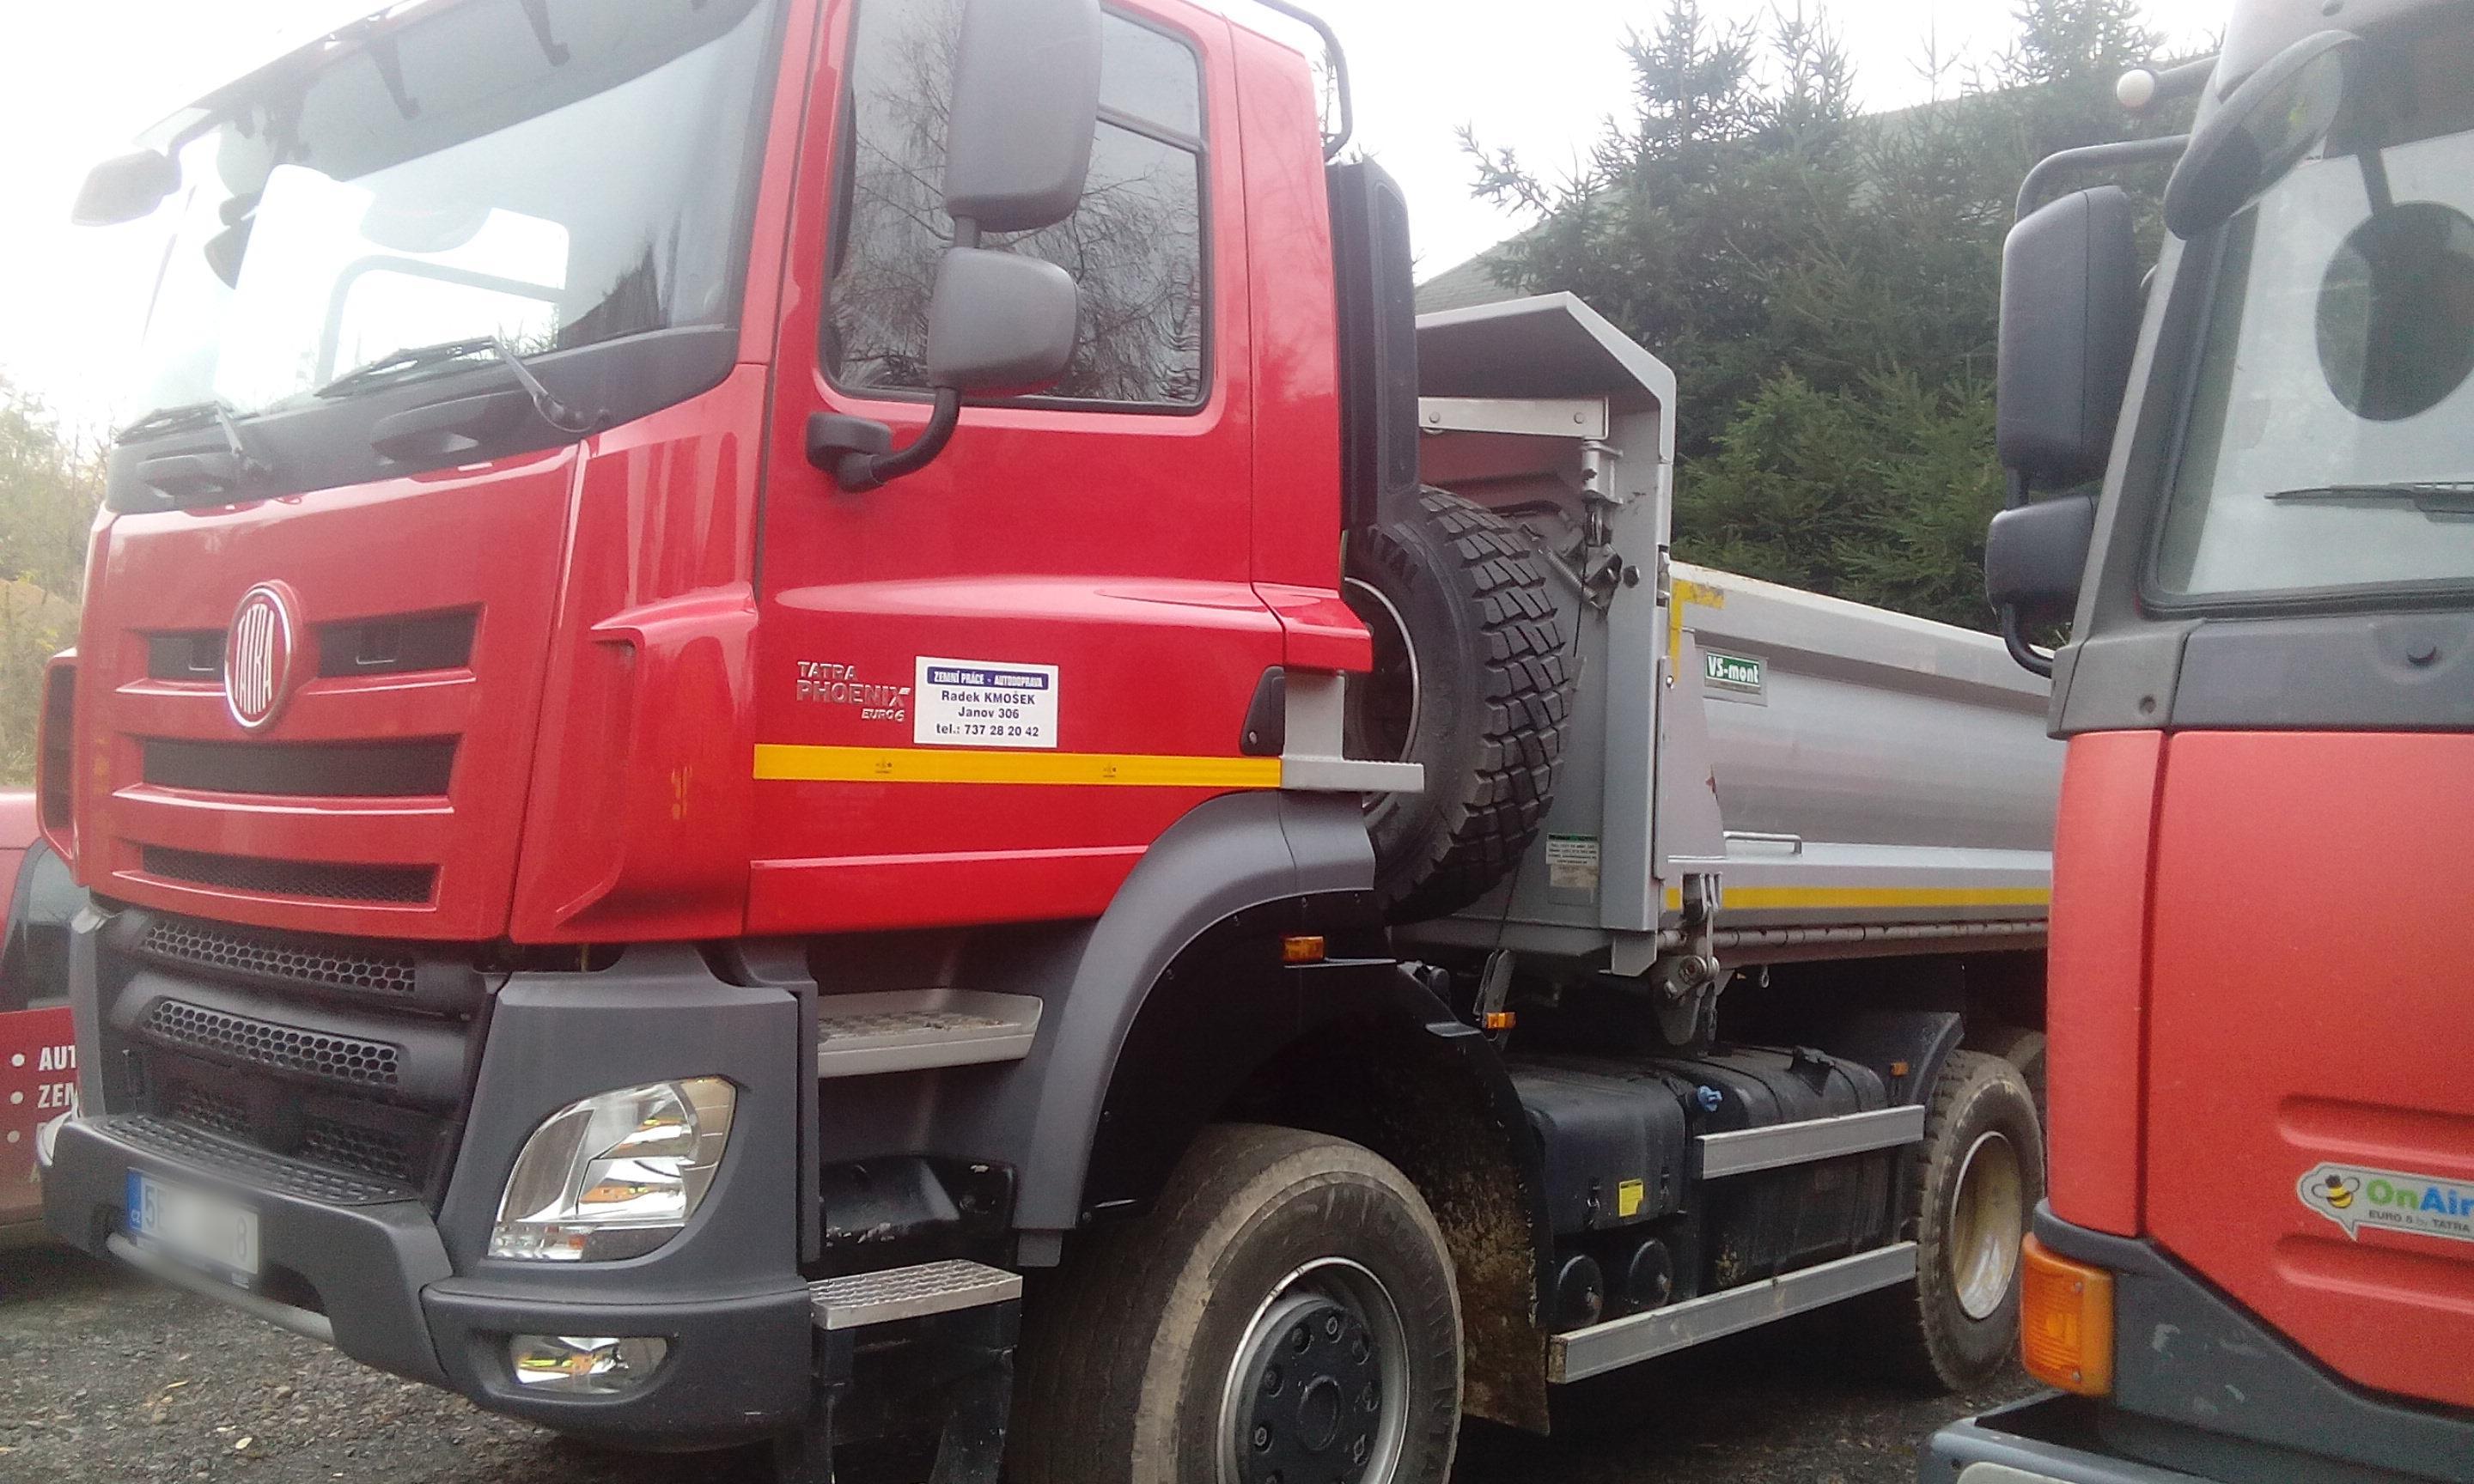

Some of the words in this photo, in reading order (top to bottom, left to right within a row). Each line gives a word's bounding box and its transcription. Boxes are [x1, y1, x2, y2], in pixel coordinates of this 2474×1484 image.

[235, 603, 275, 715] TATRA
[1708, 655, 1758, 684] VS-mont
[797, 660, 858, 681] TATRA
[960, 671, 984, 684] PRÁCE
[796, 679, 911, 708] PHOENIX
[941, 690, 980, 702] Radek
[984, 690, 1035, 705] KMOŠEK
[958, 706, 995, 718] Janov
[998, 708, 1020, 719] 306
[965, 724, 985, 735] 737
[990, 725, 1004, 736] 28
[1008, 726, 1021, 737] 20
[1025, 727, 1039, 737] 42
[2367, 1178, 2474, 1217] OnAir
[2368, 1209, 2403, 1223] EURO
[2433, 1218, 2471, 1233] TATRA
